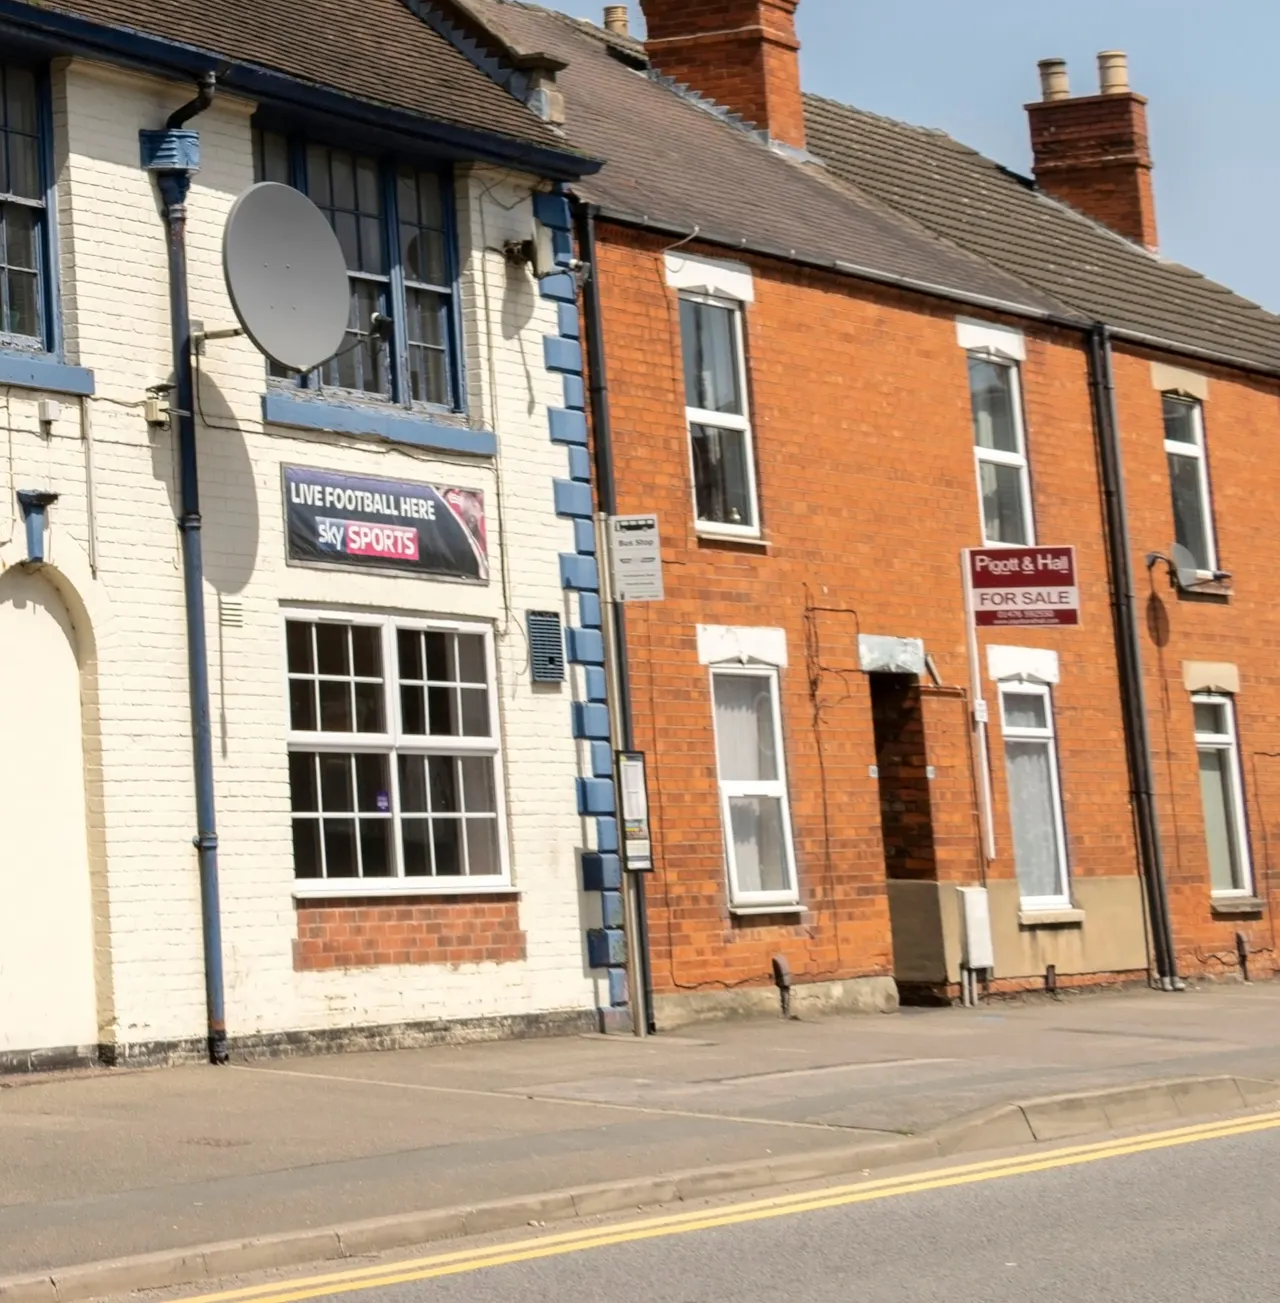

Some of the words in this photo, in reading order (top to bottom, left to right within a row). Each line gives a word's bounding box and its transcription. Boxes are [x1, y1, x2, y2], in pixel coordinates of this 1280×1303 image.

[290, 482, 324, 507] LIVE
[325, 486, 399, 516] FOOTBALL
[400, 497, 437, 521] HERE
[318, 519, 344, 551] sky
[347, 526, 415, 555] SPORTS
[974, 555, 1020, 575] Pigott
[1022, 555, 1035, 571] &
[1036, 553, 1069, 571] Hall
[980, 592, 1017, 605] FOR
[1022, 591, 1070, 605] SALE
